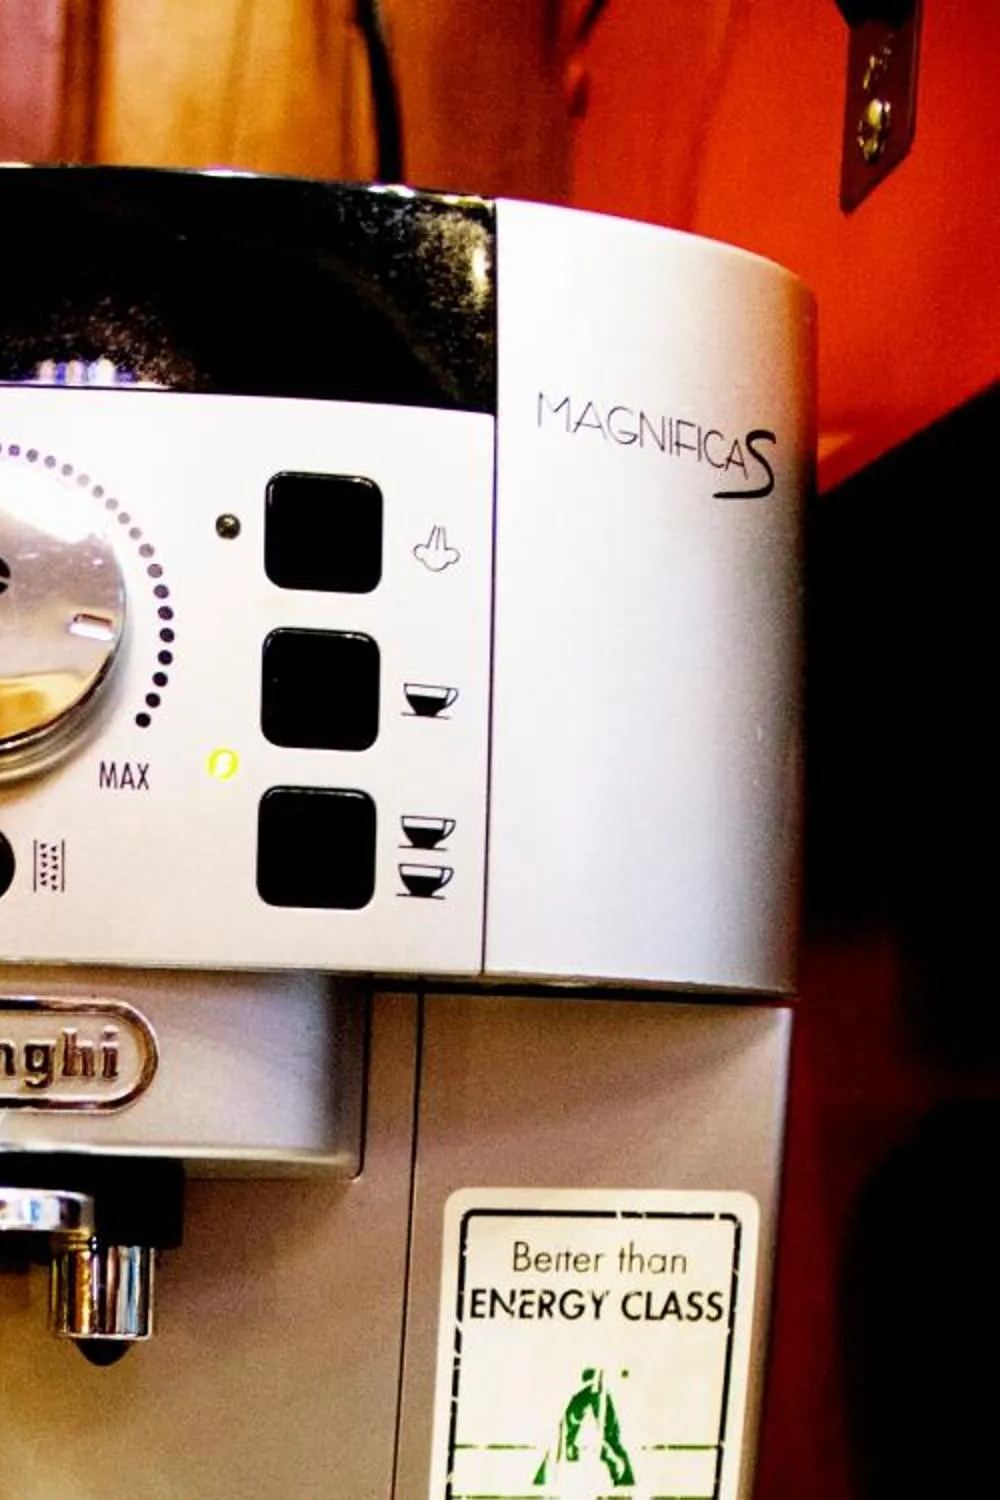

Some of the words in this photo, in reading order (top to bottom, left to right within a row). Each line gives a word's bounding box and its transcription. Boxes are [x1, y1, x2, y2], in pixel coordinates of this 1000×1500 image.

[99, 761, 151, 790] MAX
[619, 1242, 688, 1275] than
[470, 1288, 609, 1320] ENERGY
[621, 1291, 724, 1322] CLASS
